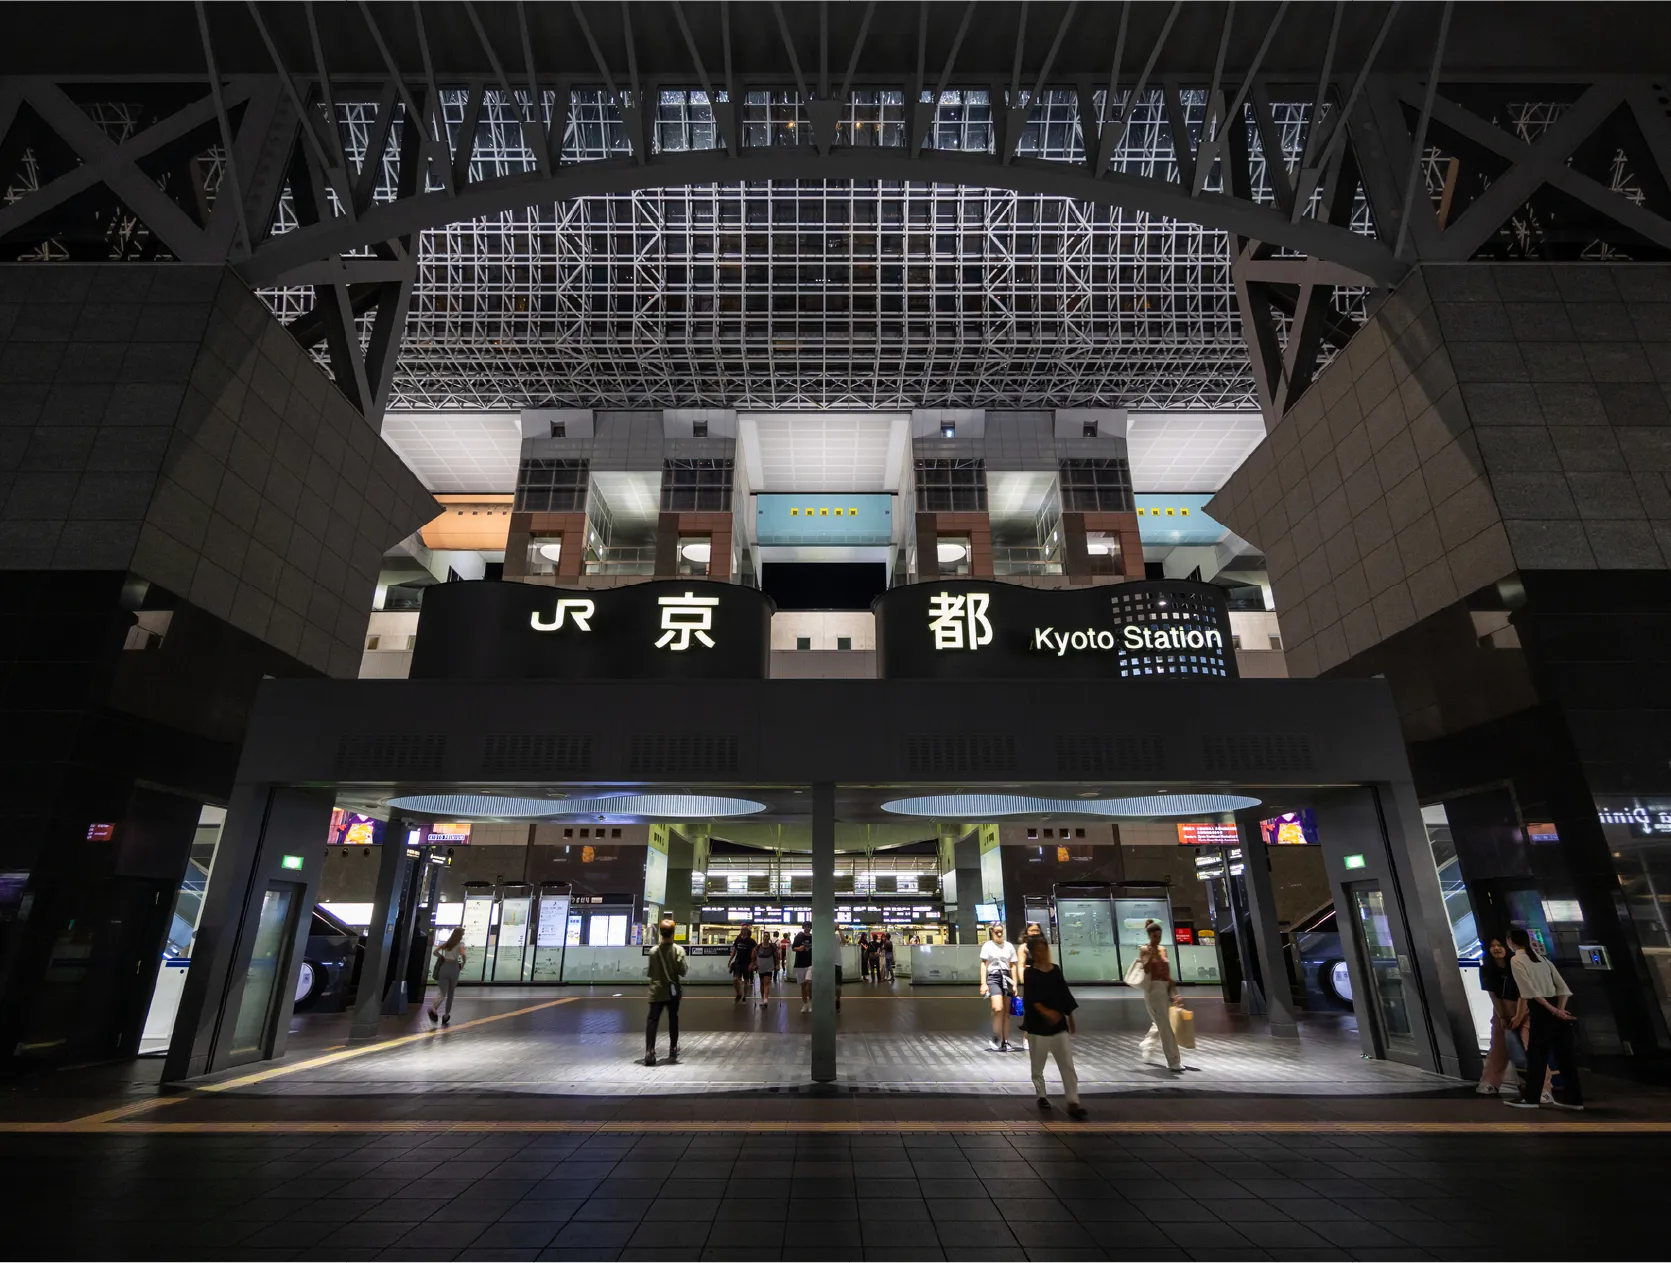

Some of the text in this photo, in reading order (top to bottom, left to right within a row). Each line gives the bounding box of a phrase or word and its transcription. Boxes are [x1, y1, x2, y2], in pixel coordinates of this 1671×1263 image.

[530, 599, 595, 631] JR
[654, 592, 719, 650] 京
[928, 592, 993, 650] 都
[1034, 625, 1223, 656] Kyoto Station
